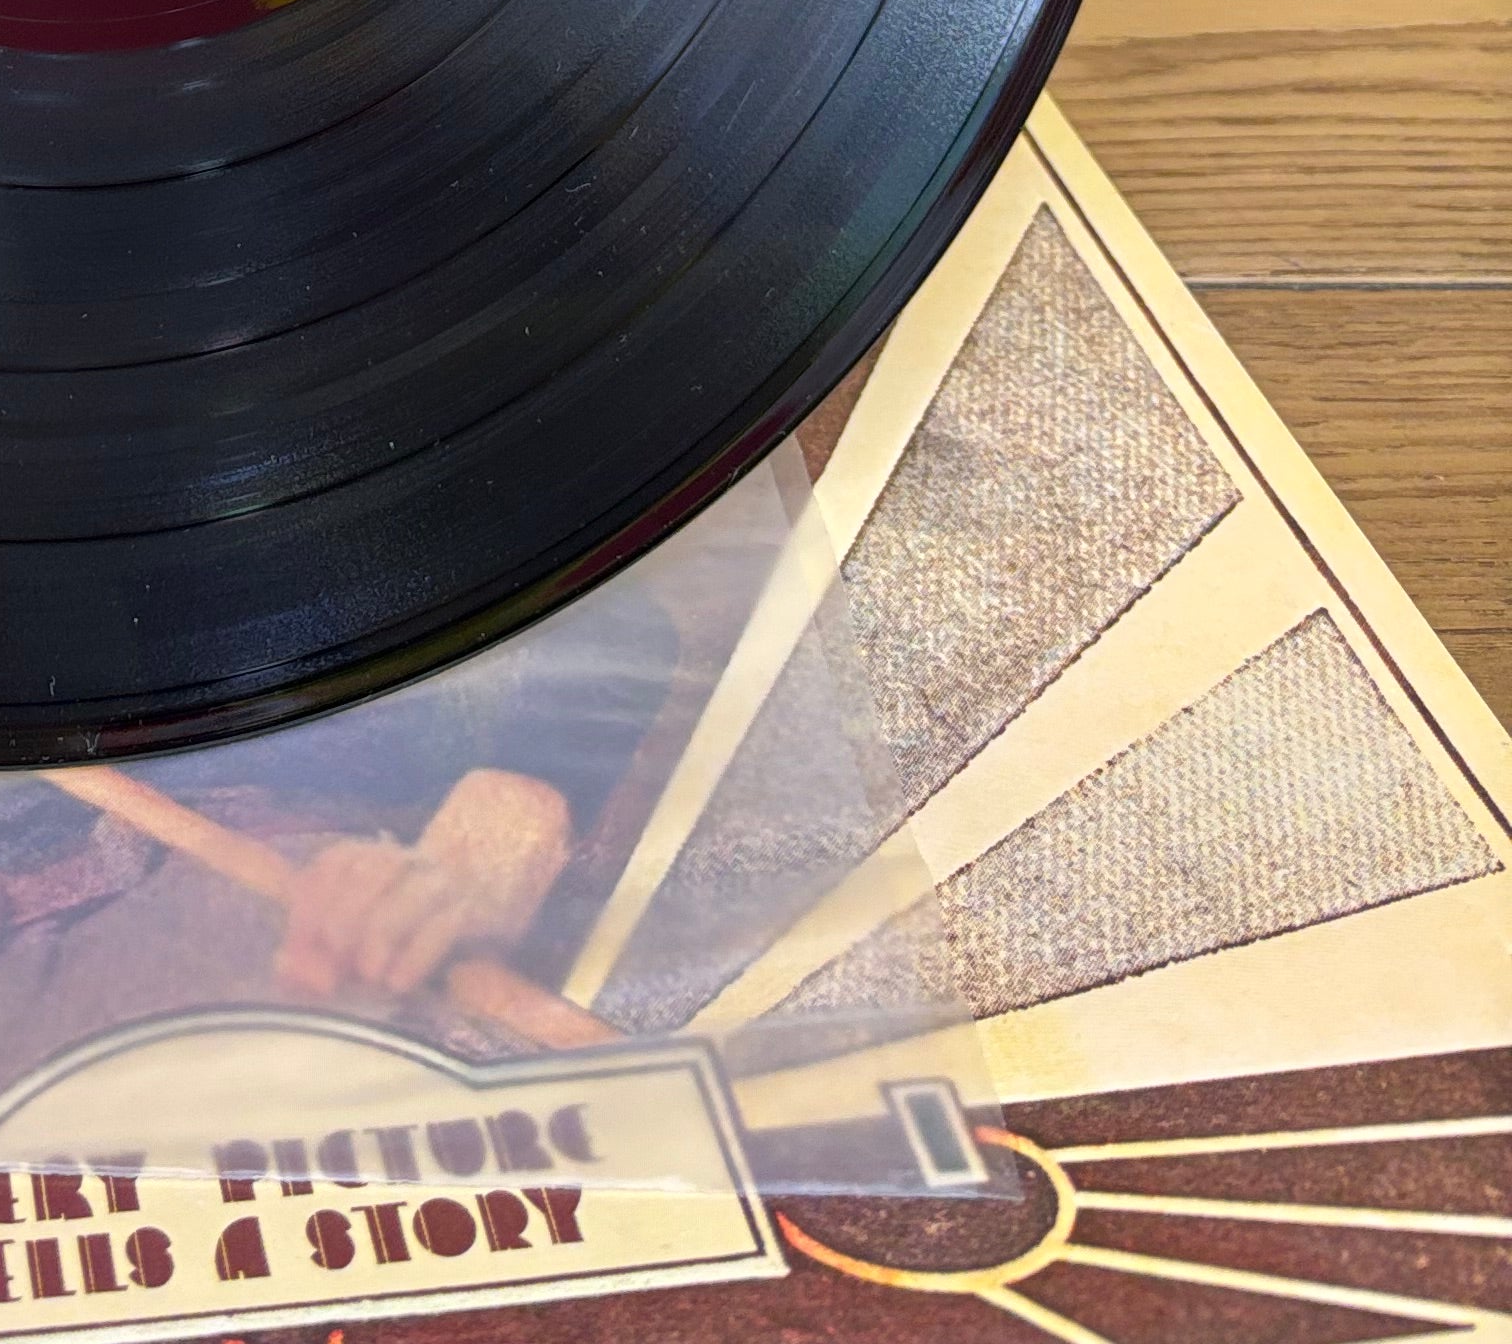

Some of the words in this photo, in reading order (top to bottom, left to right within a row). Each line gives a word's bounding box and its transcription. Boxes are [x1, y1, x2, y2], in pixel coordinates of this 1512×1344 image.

[212, 1103, 603, 1203] PICTURE
[214, 1215, 272, 1281] A
[305, 1183, 585, 1270] STORY
